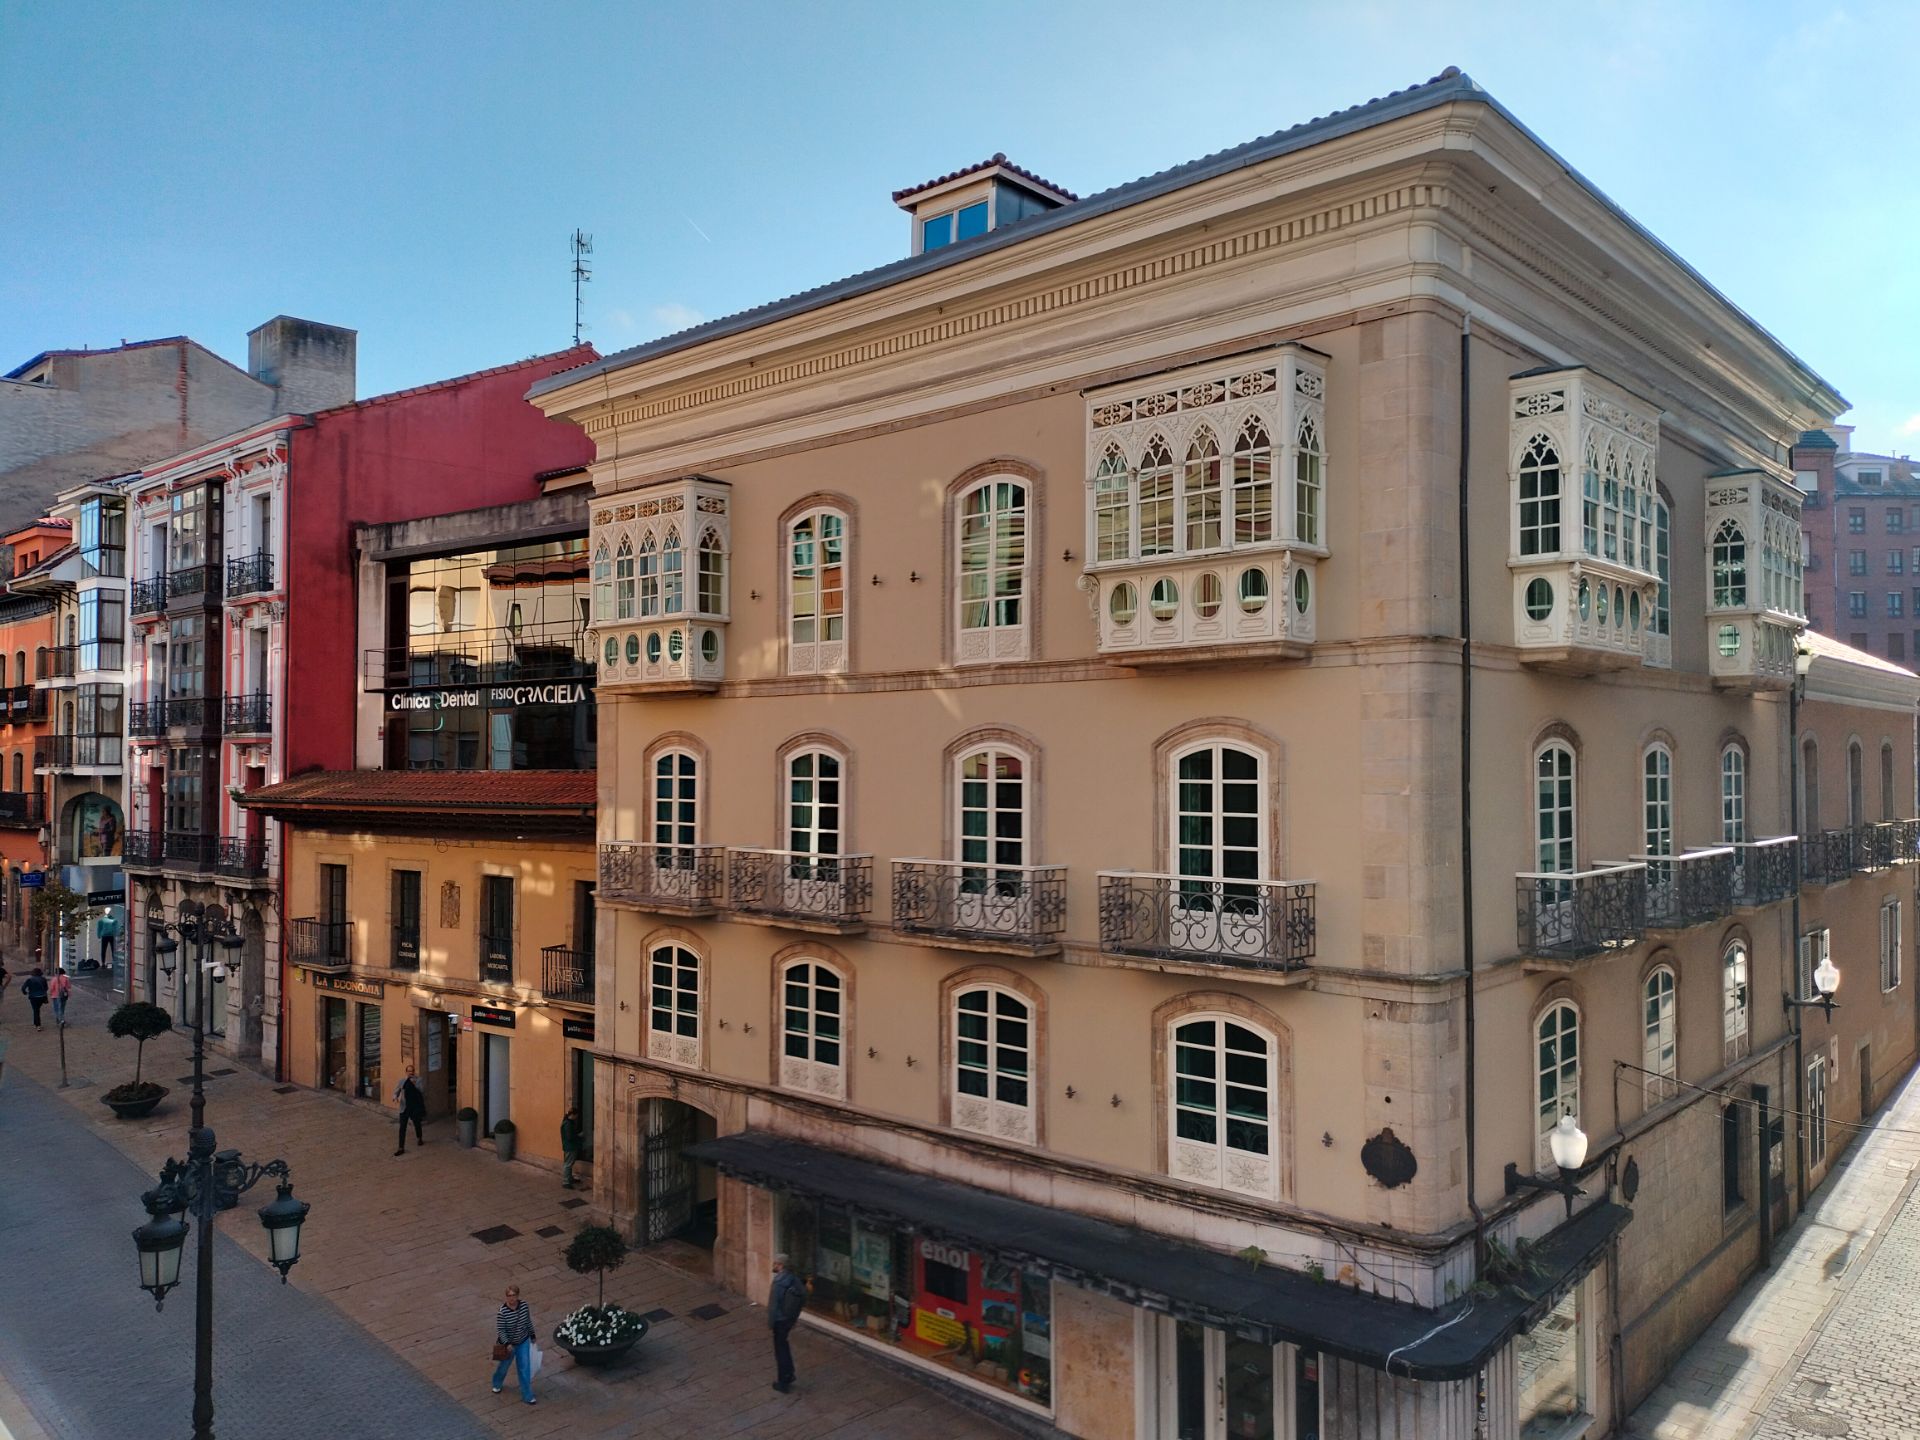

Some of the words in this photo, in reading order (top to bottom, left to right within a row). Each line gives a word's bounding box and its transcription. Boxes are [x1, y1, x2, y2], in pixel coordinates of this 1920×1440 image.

[392, 691, 430, 710] Clínica
[441, 689, 479, 708] Dental
[491, 687, 514, 701] FISIO
[514, 684, 586, 706] GRACIELA
[316, 975, 328, 988] LA
[920, 1239, 970, 1272] enol
